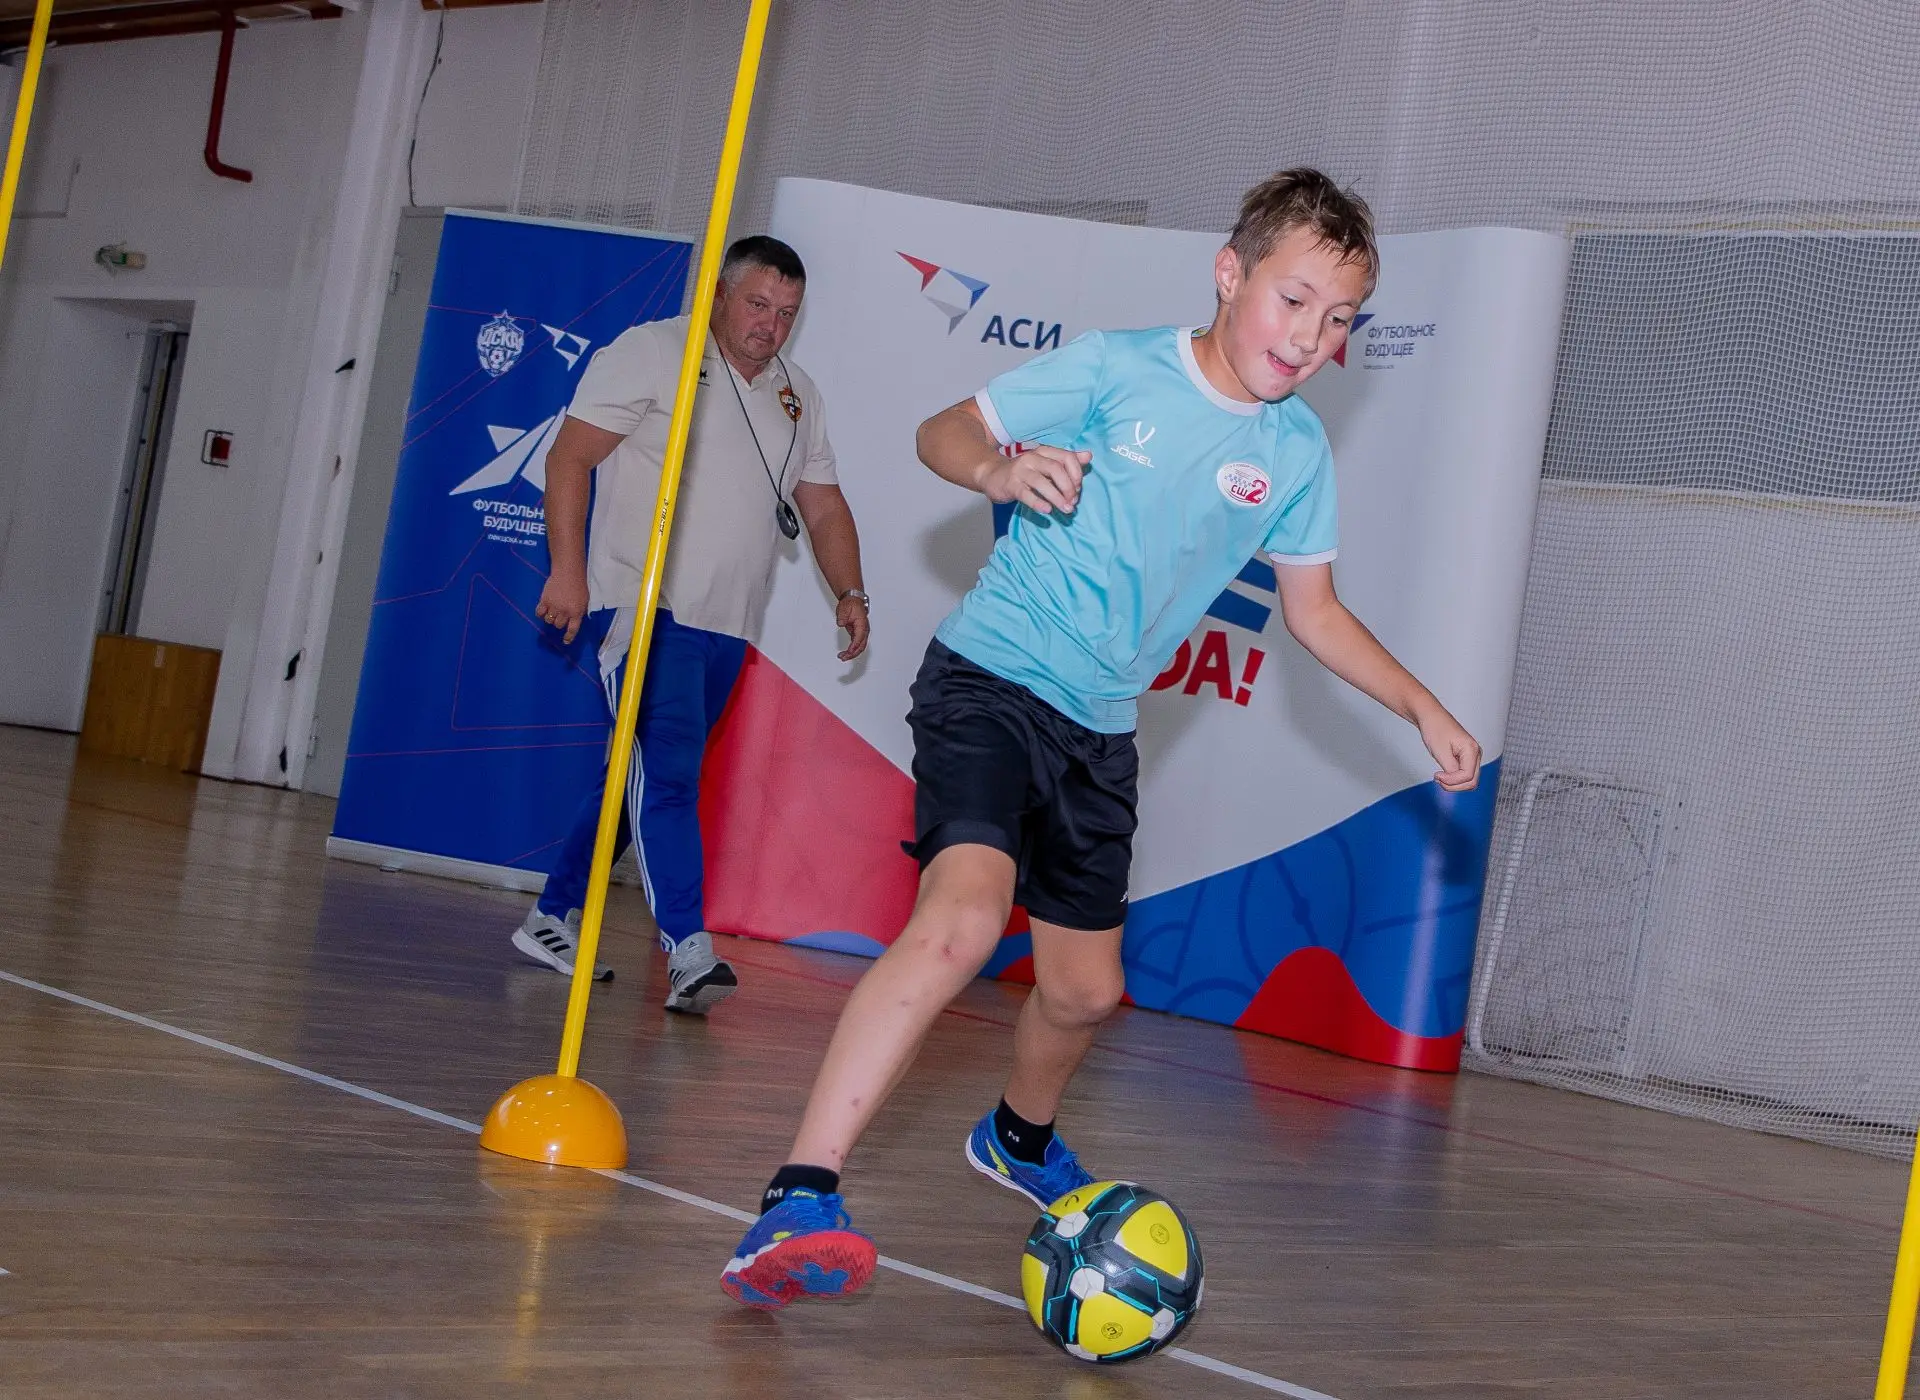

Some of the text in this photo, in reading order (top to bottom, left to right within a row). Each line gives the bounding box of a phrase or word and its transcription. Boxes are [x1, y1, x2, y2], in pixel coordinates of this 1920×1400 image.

[981, 315, 1062, 350] АСИ
[1368, 323, 1436, 339] ФУТБОЛЬНОЕ
[1365, 342, 1415, 357] БУДУЩЕЕ
[472, 498, 545, 519] ФУТБОЛЬН
[483, 515, 546, 535] БУДУЩЕЕ
